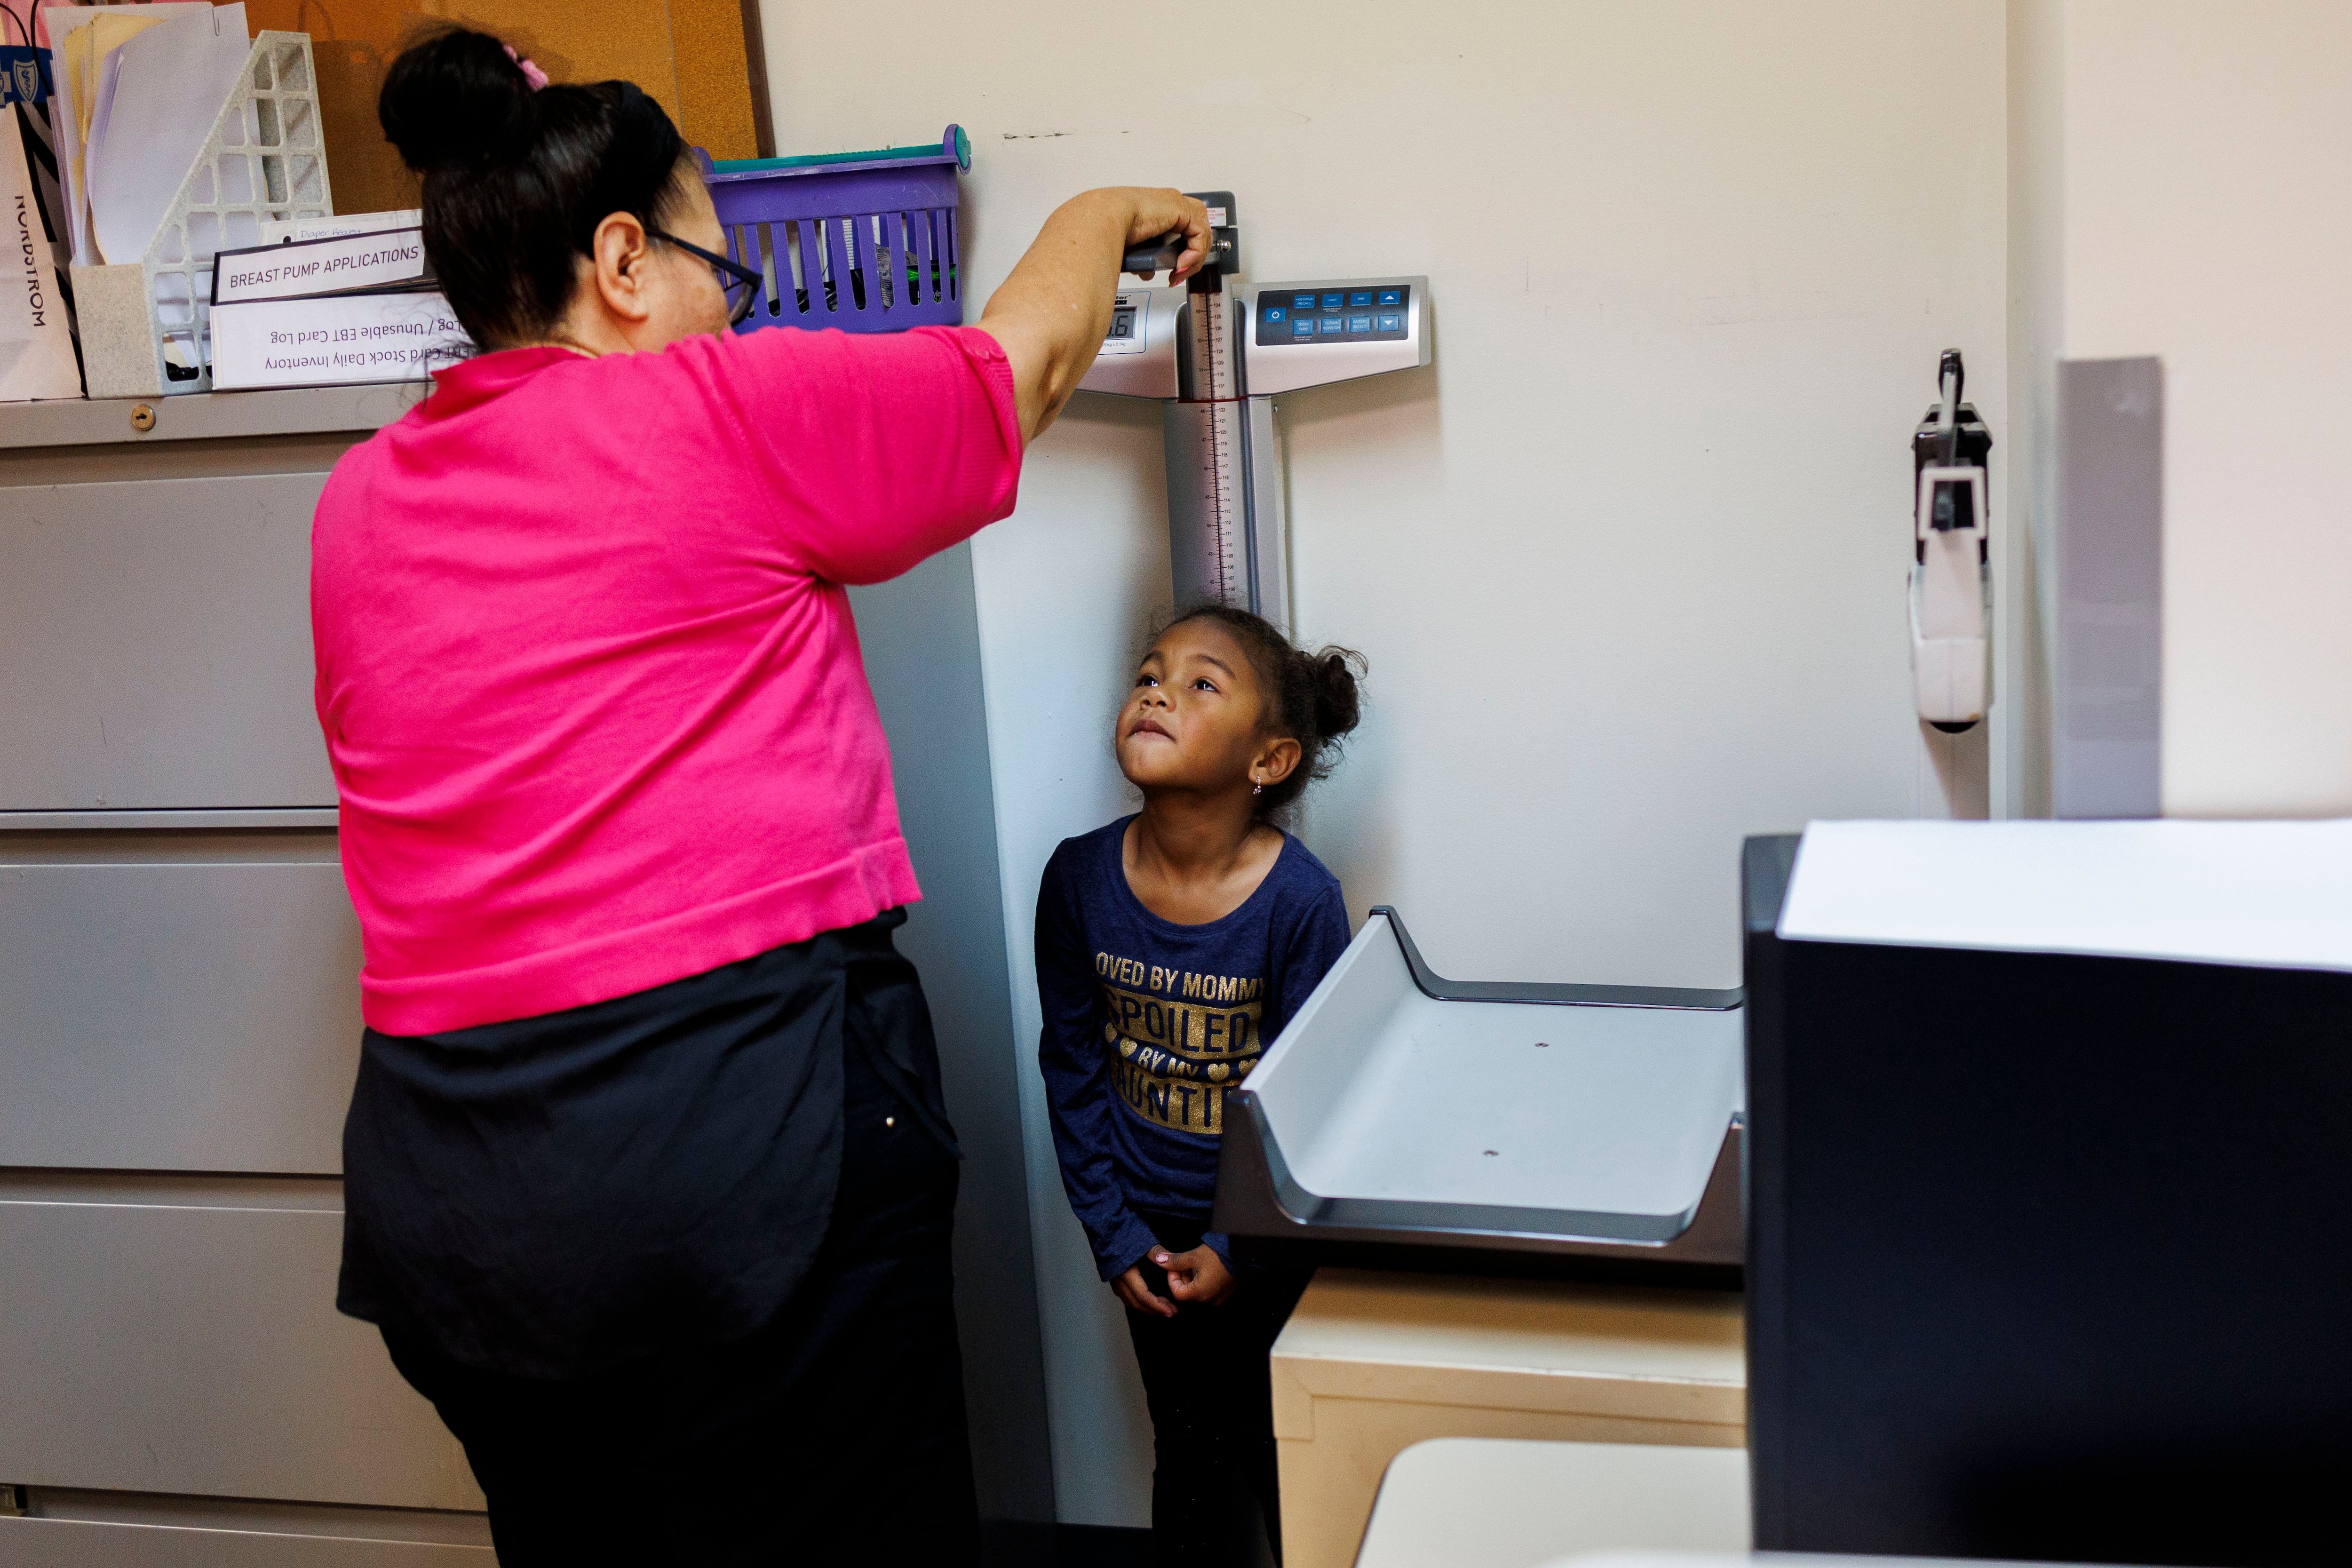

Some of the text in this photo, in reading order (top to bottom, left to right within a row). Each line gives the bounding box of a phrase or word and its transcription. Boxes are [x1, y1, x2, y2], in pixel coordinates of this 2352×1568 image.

[301, 230, 329, 239] Diaper
[15, 196, 47, 326] NORDSTROM
[230, 246, 419, 287] BREAST PUMP APPLICATIONS
[271, 318, 462, 345] Log / Unusable EBT Card Log
[265, 356, 328, 369] Inventory
[334, 352, 364, 367] Daily
[370, 350, 405, 365] Stock
[1150, 966, 1178, 993] BY
[1106, 990, 1250, 1053] SPOILED
[1138, 1046, 1199, 1077] BY MY
[1117, 1060, 1226, 1128] AUNTI
